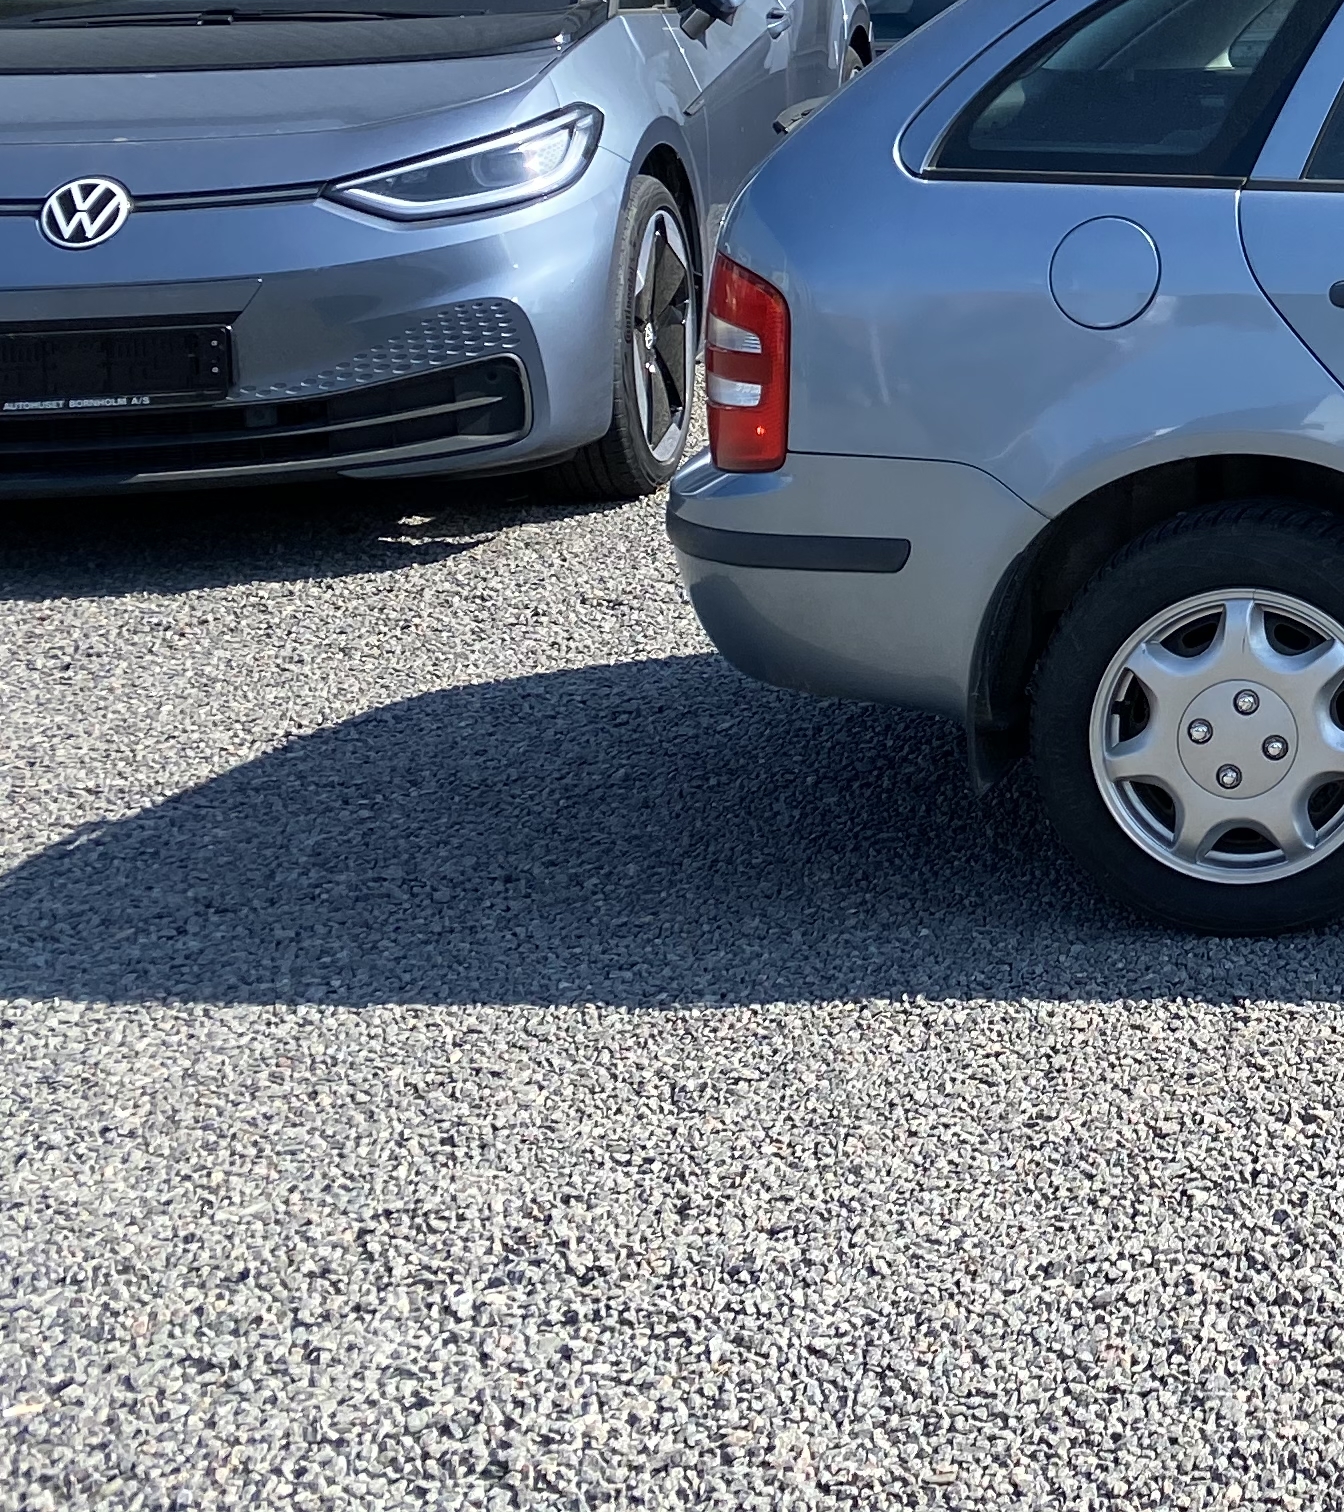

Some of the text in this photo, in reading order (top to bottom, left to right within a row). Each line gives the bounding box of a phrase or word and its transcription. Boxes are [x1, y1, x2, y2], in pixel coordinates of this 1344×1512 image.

[3, 396, 150, 410] AUTOHUSET BORNHOLM A/S
